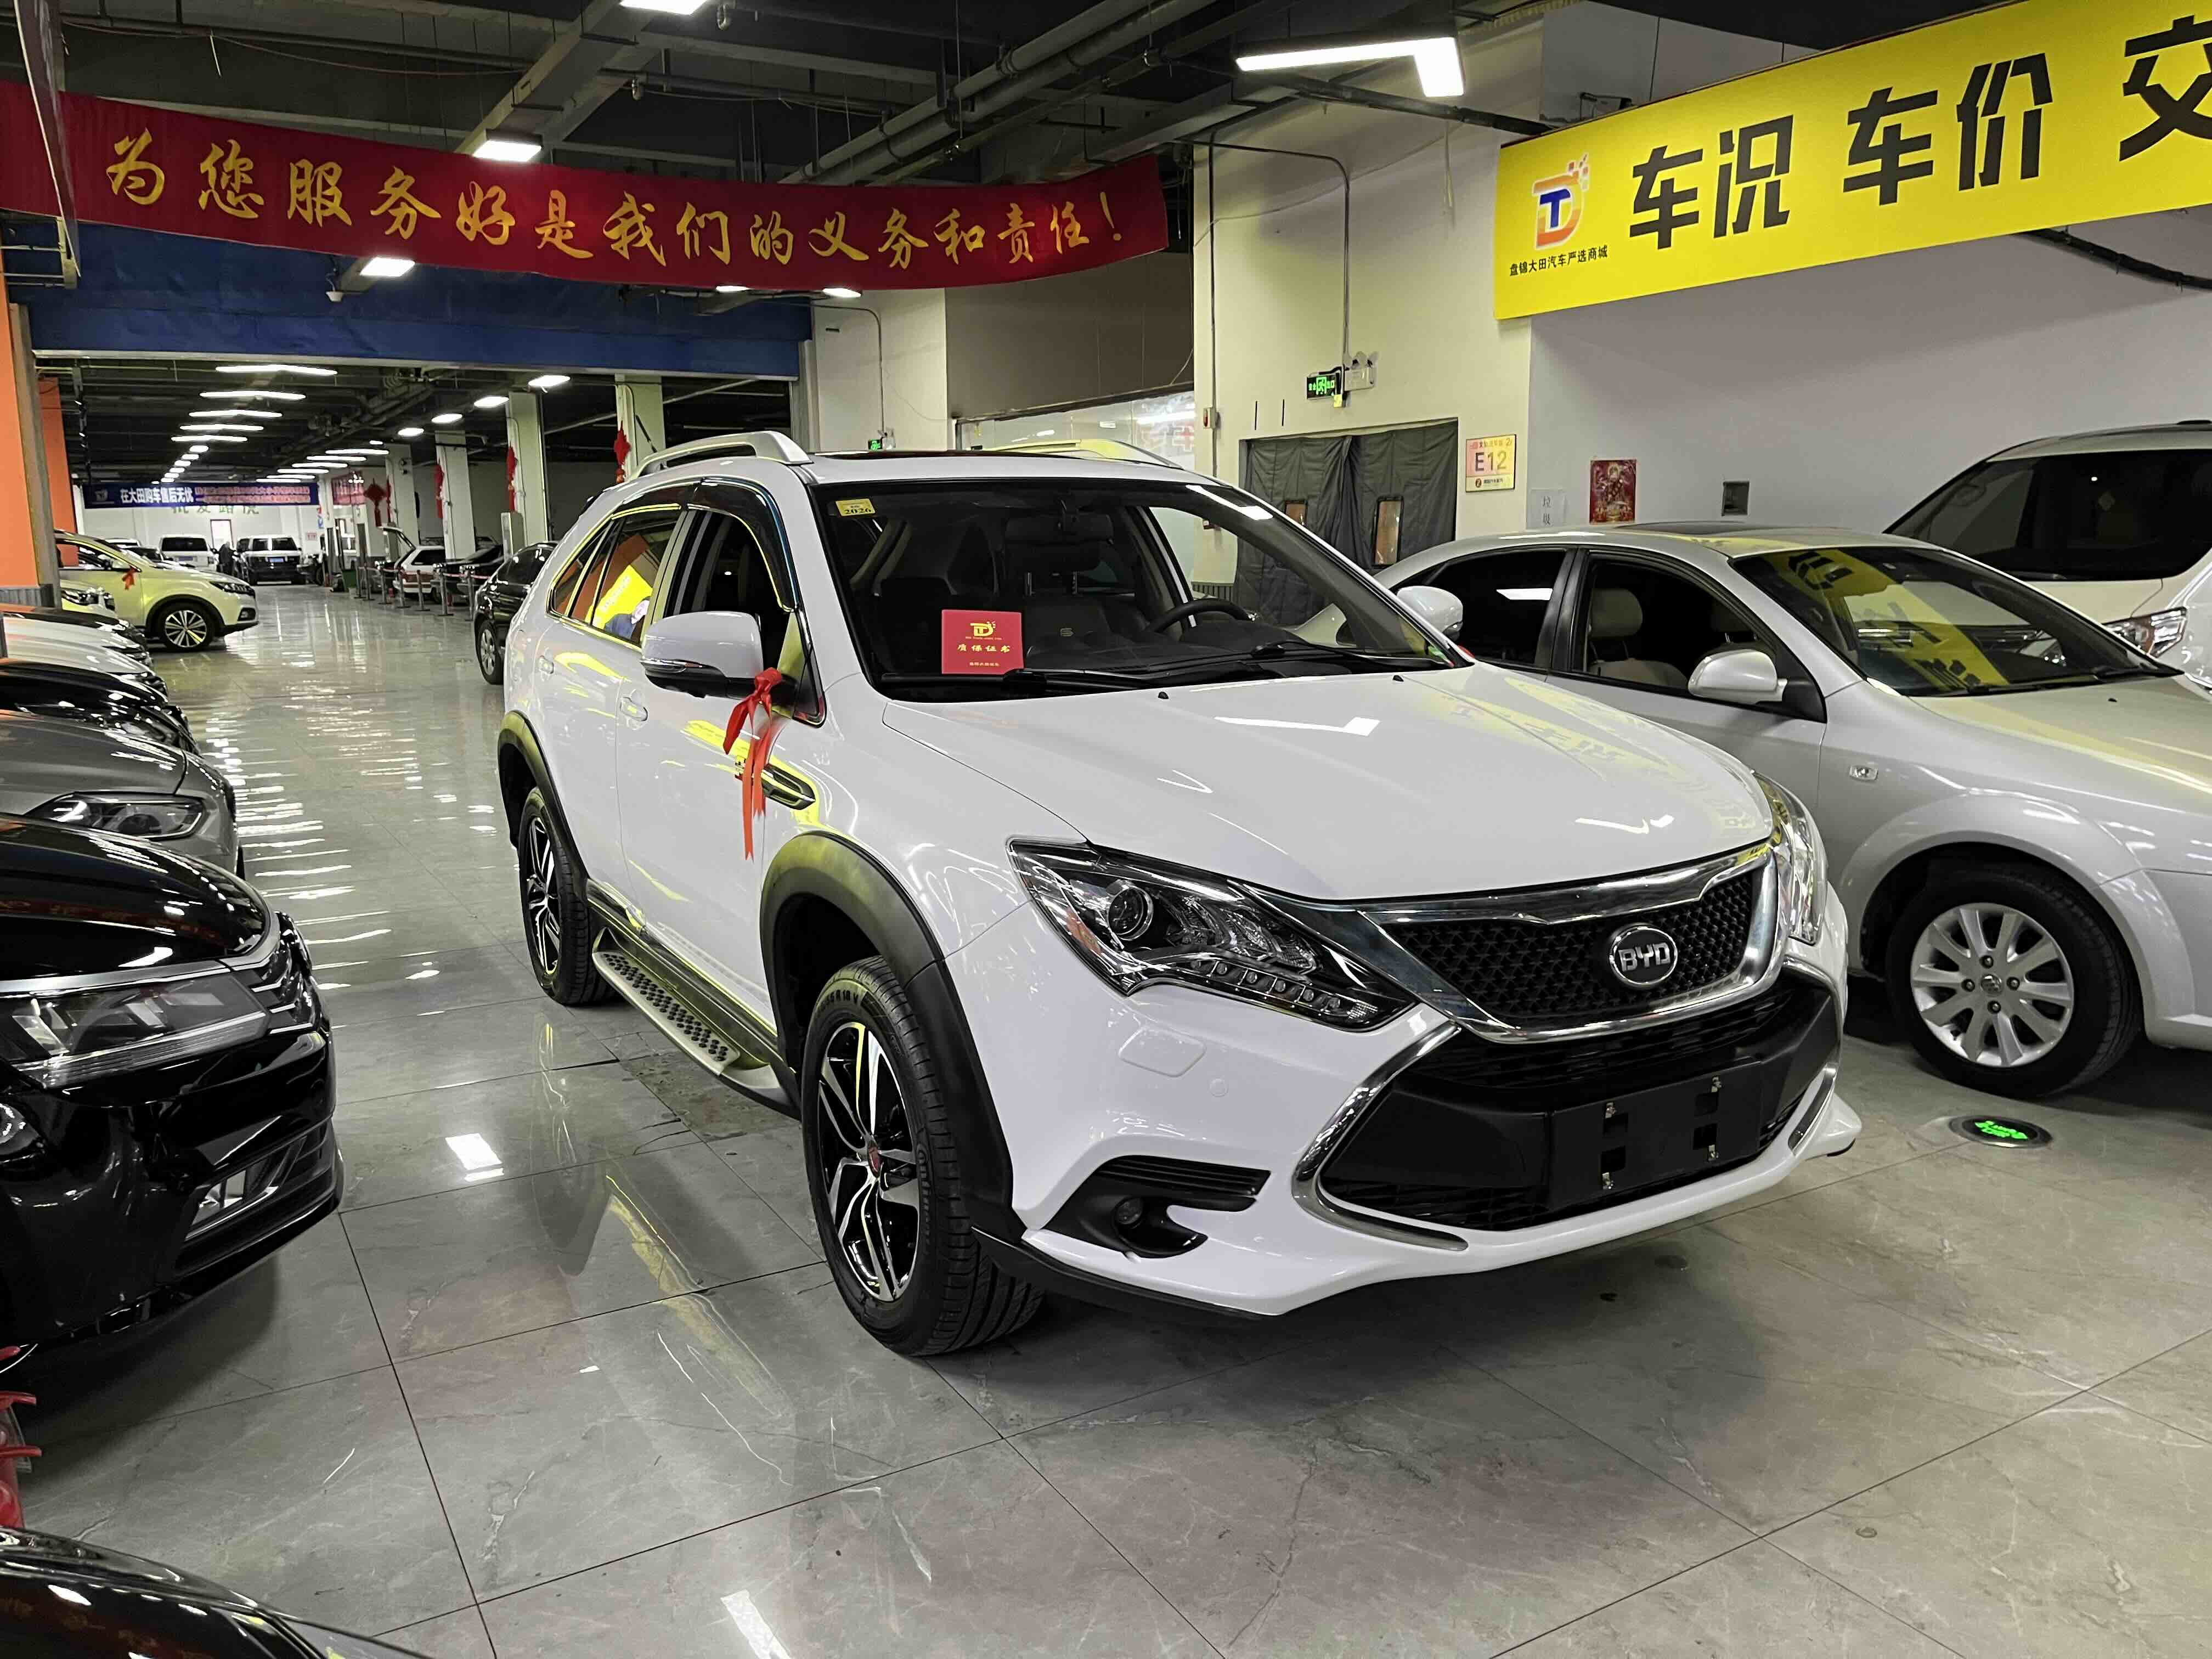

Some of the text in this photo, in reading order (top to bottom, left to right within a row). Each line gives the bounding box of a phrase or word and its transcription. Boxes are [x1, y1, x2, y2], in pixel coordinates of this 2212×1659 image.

[1629, 15, 2212, 250] 车况 车价 交
[1510, 245, 1608, 276] 盘锦大田汽车严选商城
[1475, 451, 1506, 471] E12
[120, 487, 194, 504] 在大田购车售后无忧
[957, 644, 1011, 653] 质保证书
[1618, 942, 1671, 972] BYD
